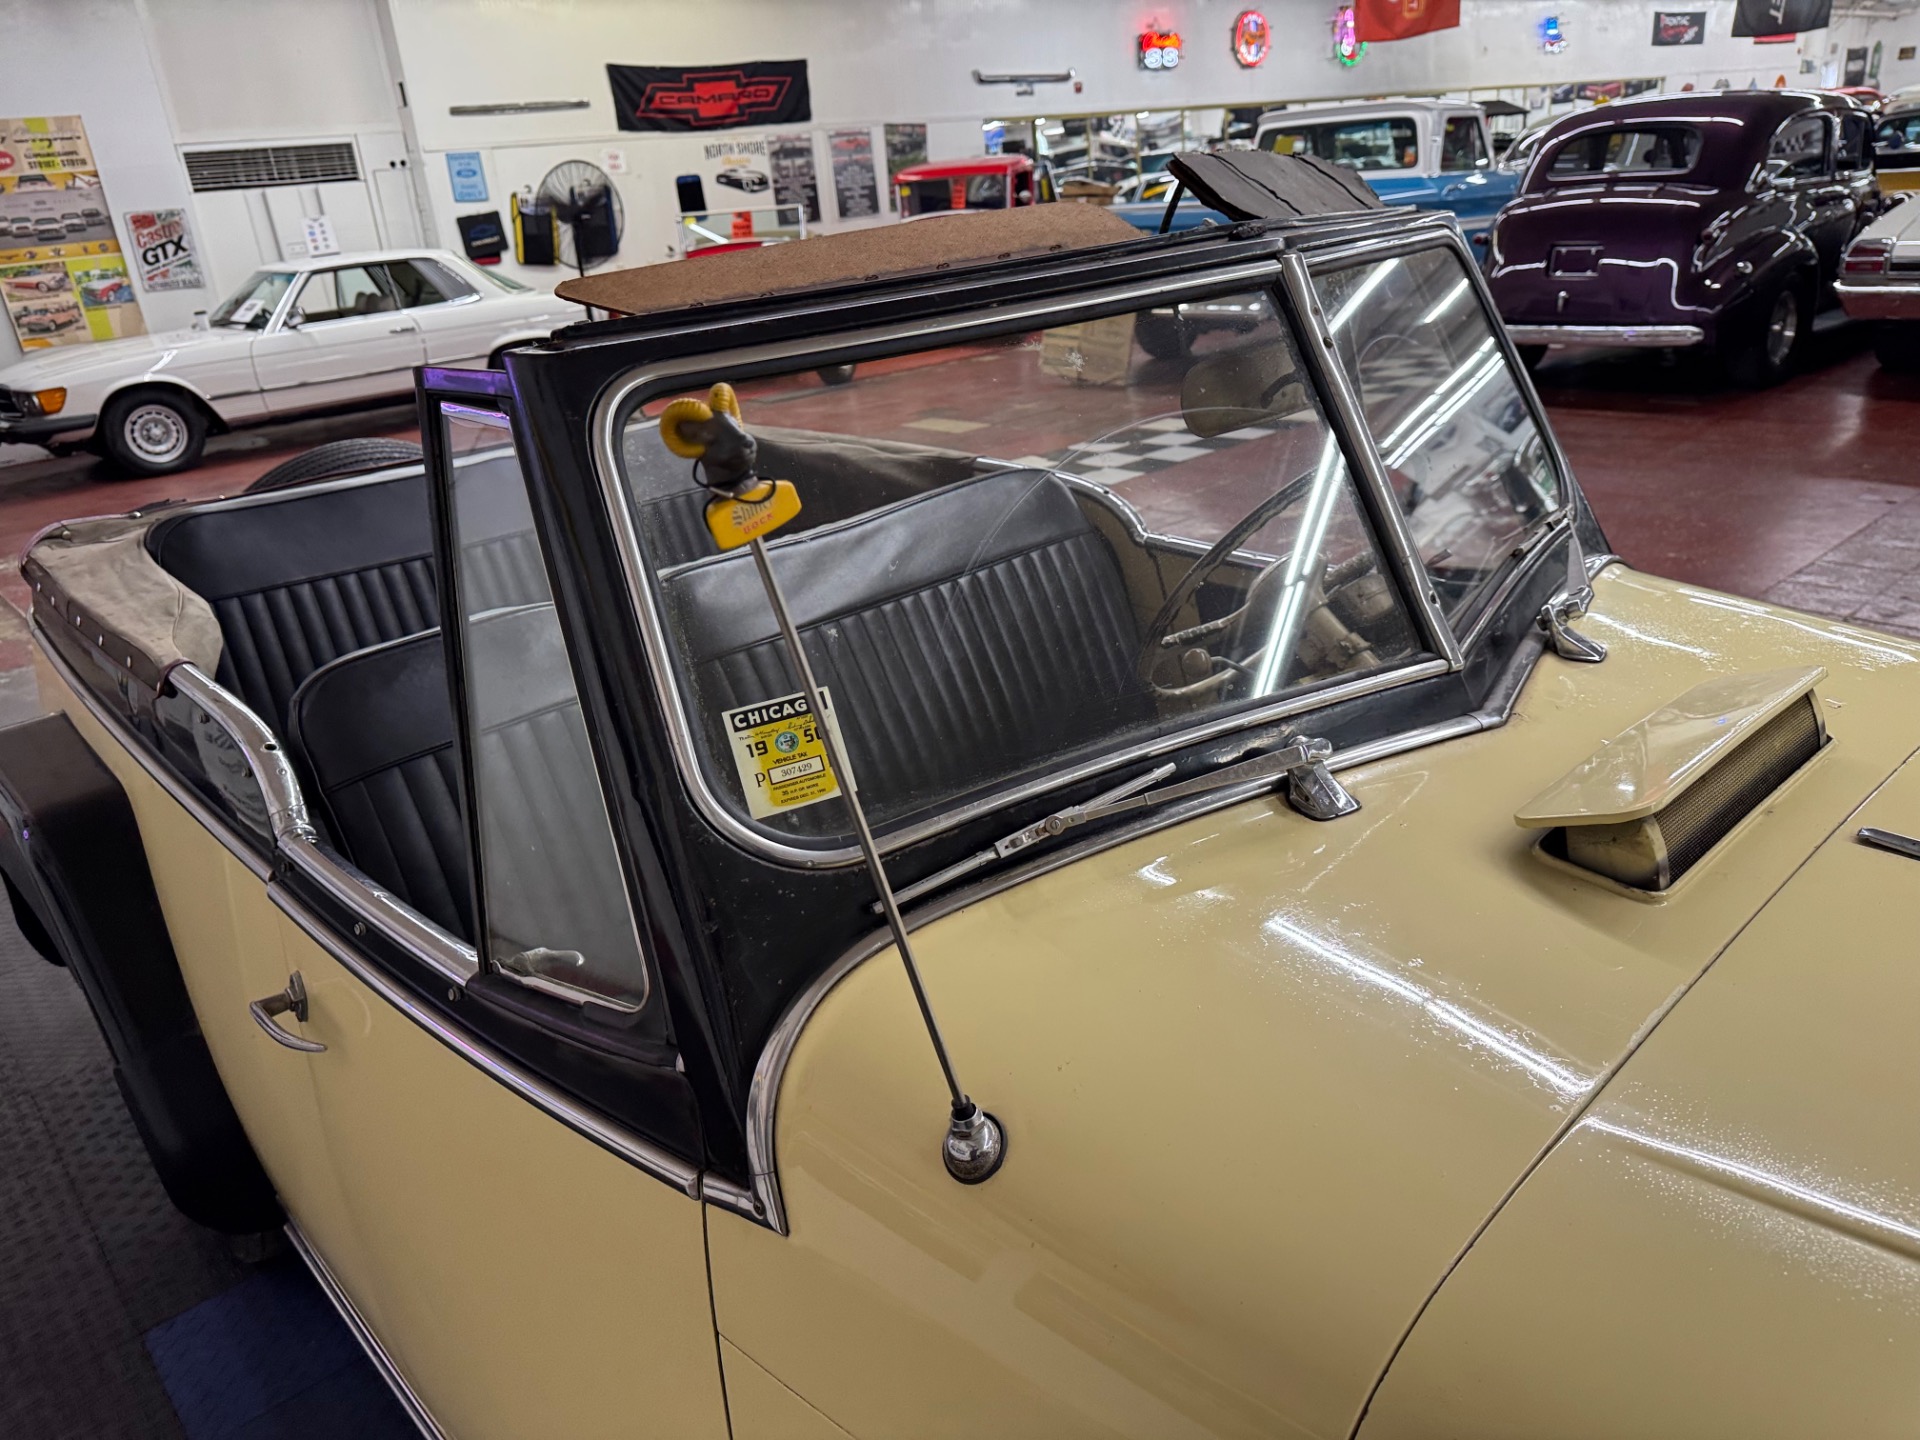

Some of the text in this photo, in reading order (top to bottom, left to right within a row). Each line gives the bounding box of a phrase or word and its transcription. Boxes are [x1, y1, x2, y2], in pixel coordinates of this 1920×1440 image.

[660, 88, 771, 105] CAMARO
[704, 140, 766, 160] NORTH SHORE
[142, 234, 189, 266] GTX
[743, 512, 775, 535] BOCK
[733, 698, 808, 729] CHICAG
[745, 740, 769, 758] 19
[772, 751, 808, 765] VEHICLE TAX
[754, 762, 813, 788] P 307429
